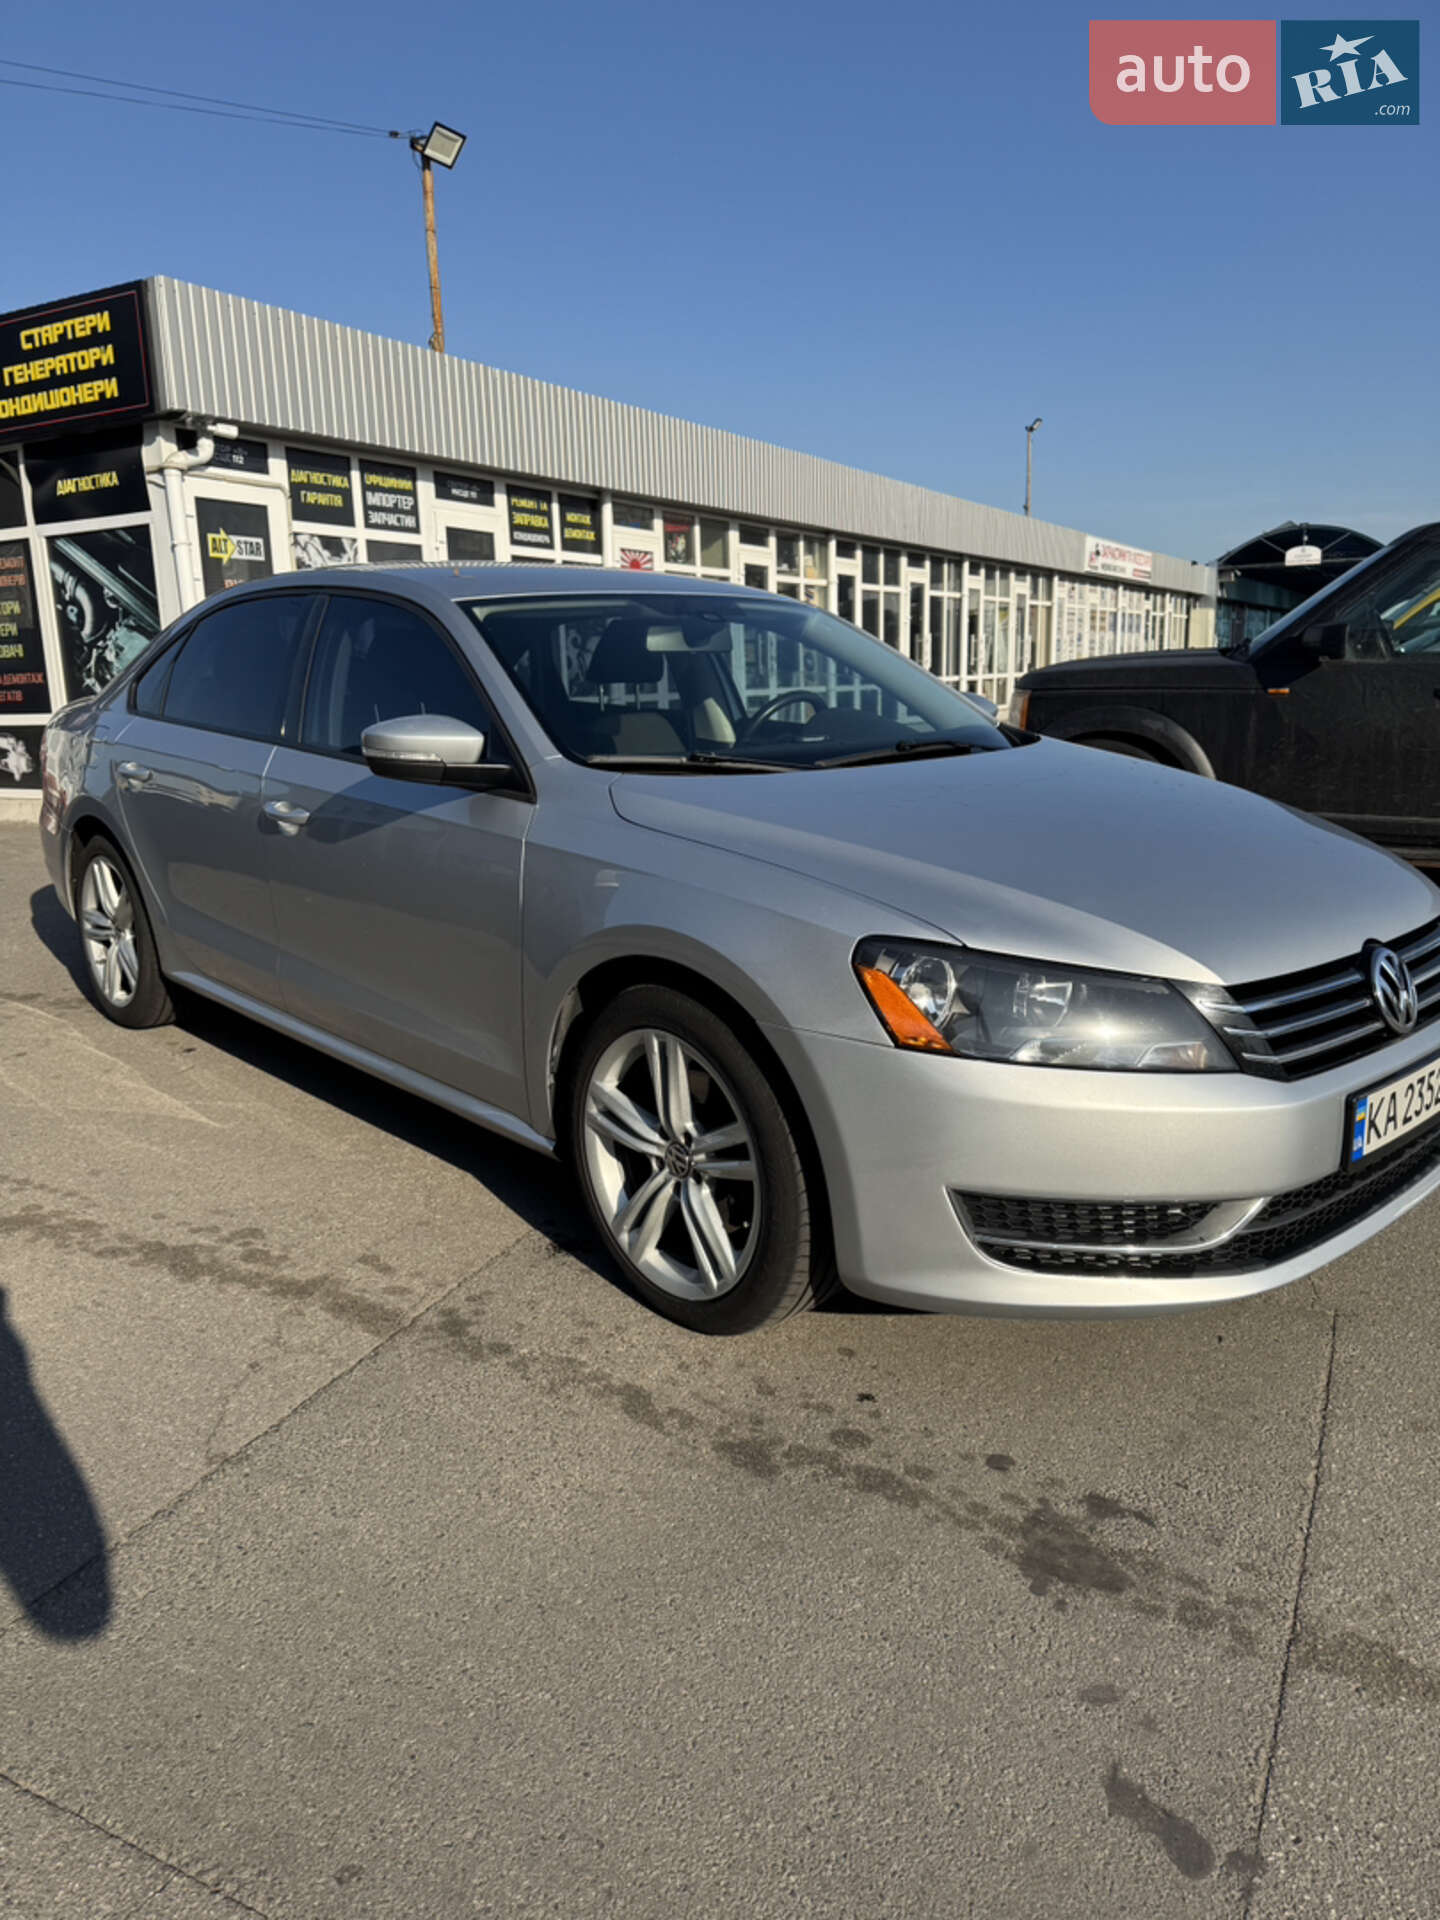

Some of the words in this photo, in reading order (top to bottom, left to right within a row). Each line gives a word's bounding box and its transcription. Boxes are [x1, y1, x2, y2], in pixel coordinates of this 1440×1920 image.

[20, 310, 111, 350] СТАРТЕРИ
[3, 343, 115, 387] ГЕНЕРАТОРИ
[56, 470, 120, 496] ДІАГНОСТИКА
[290, 468, 350, 489] ДІАГНОСТИКА
[365, 491, 414, 510] ІМПОРТЕР
[210, 536, 229, 554] ALT
[236, 540, 263, 557] STAR
[1366, 1088, 1398, 1145] KA
